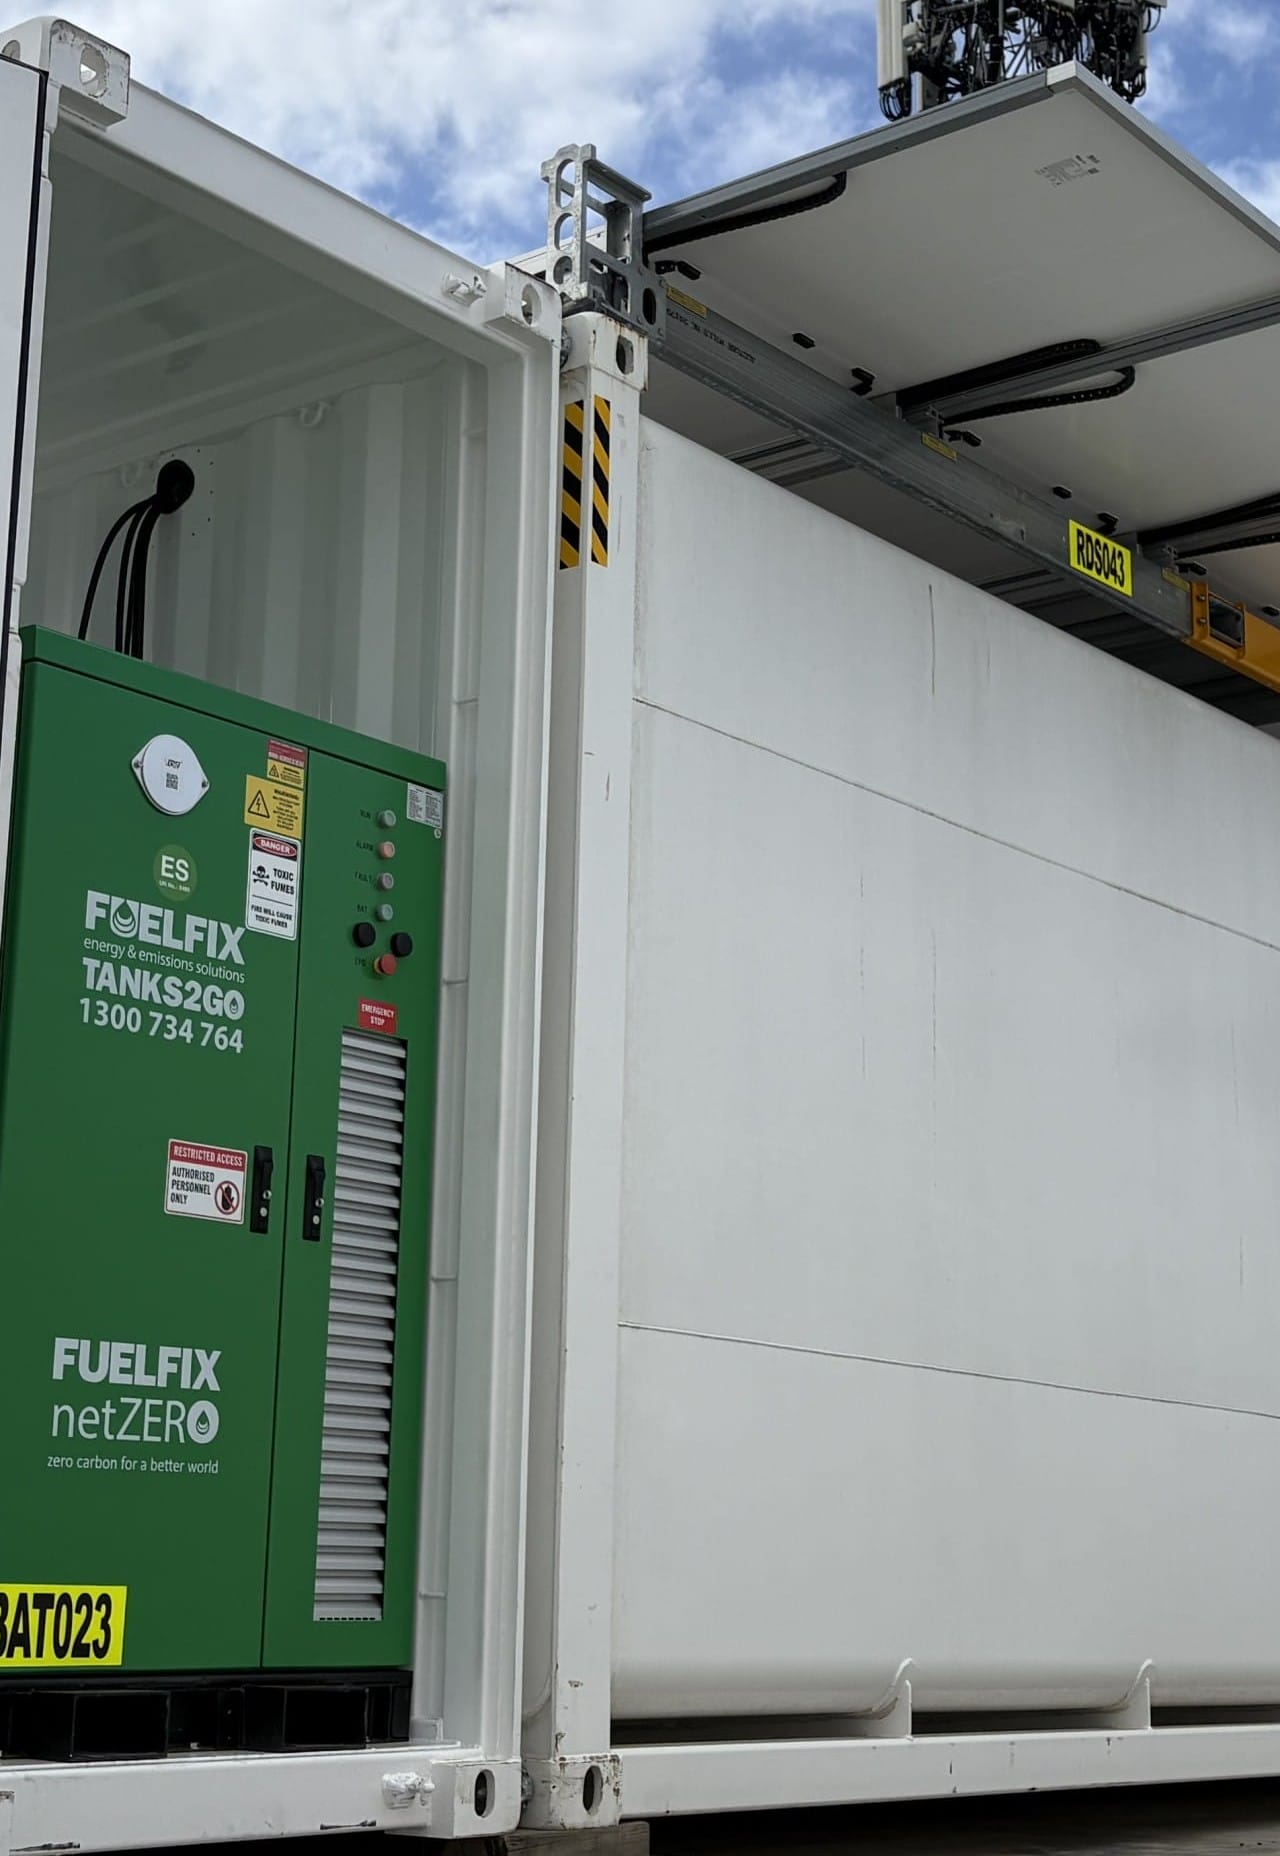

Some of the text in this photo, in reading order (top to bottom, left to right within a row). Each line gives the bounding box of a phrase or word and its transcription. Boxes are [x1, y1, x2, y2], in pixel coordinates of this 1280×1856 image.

[1077, 528, 1125, 587] RDS043
[260, 839, 290, 854] DANGER
[161, 854, 189, 882] ES
[273, 868, 294, 881] TOXIC
[271, 880, 294, 895] FUMES
[85, 890, 246, 965] FUELFIX
[84, 937, 245, 983] energy & emissions solutions
[82, 957, 245, 1021] TANKS2GO
[361, 1003, 394, 1018] EMERGENCY
[370, 1015, 385, 1026] STOP
[80, 998, 244, 1054] 1300 734 764
[174, 1145, 242, 1167] RESTRICTED ACCESS
[172, 1166, 215, 1182] AUTHORISED
[171, 1179, 211, 1195] PERSONNEL
[170, 1193, 188, 1204] ONLY
[52, 1337, 222, 1391] FUELFIX
[52, 1397, 219, 1444] netZERO
[47, 1455, 218, 1474] zero carbon for a better world
